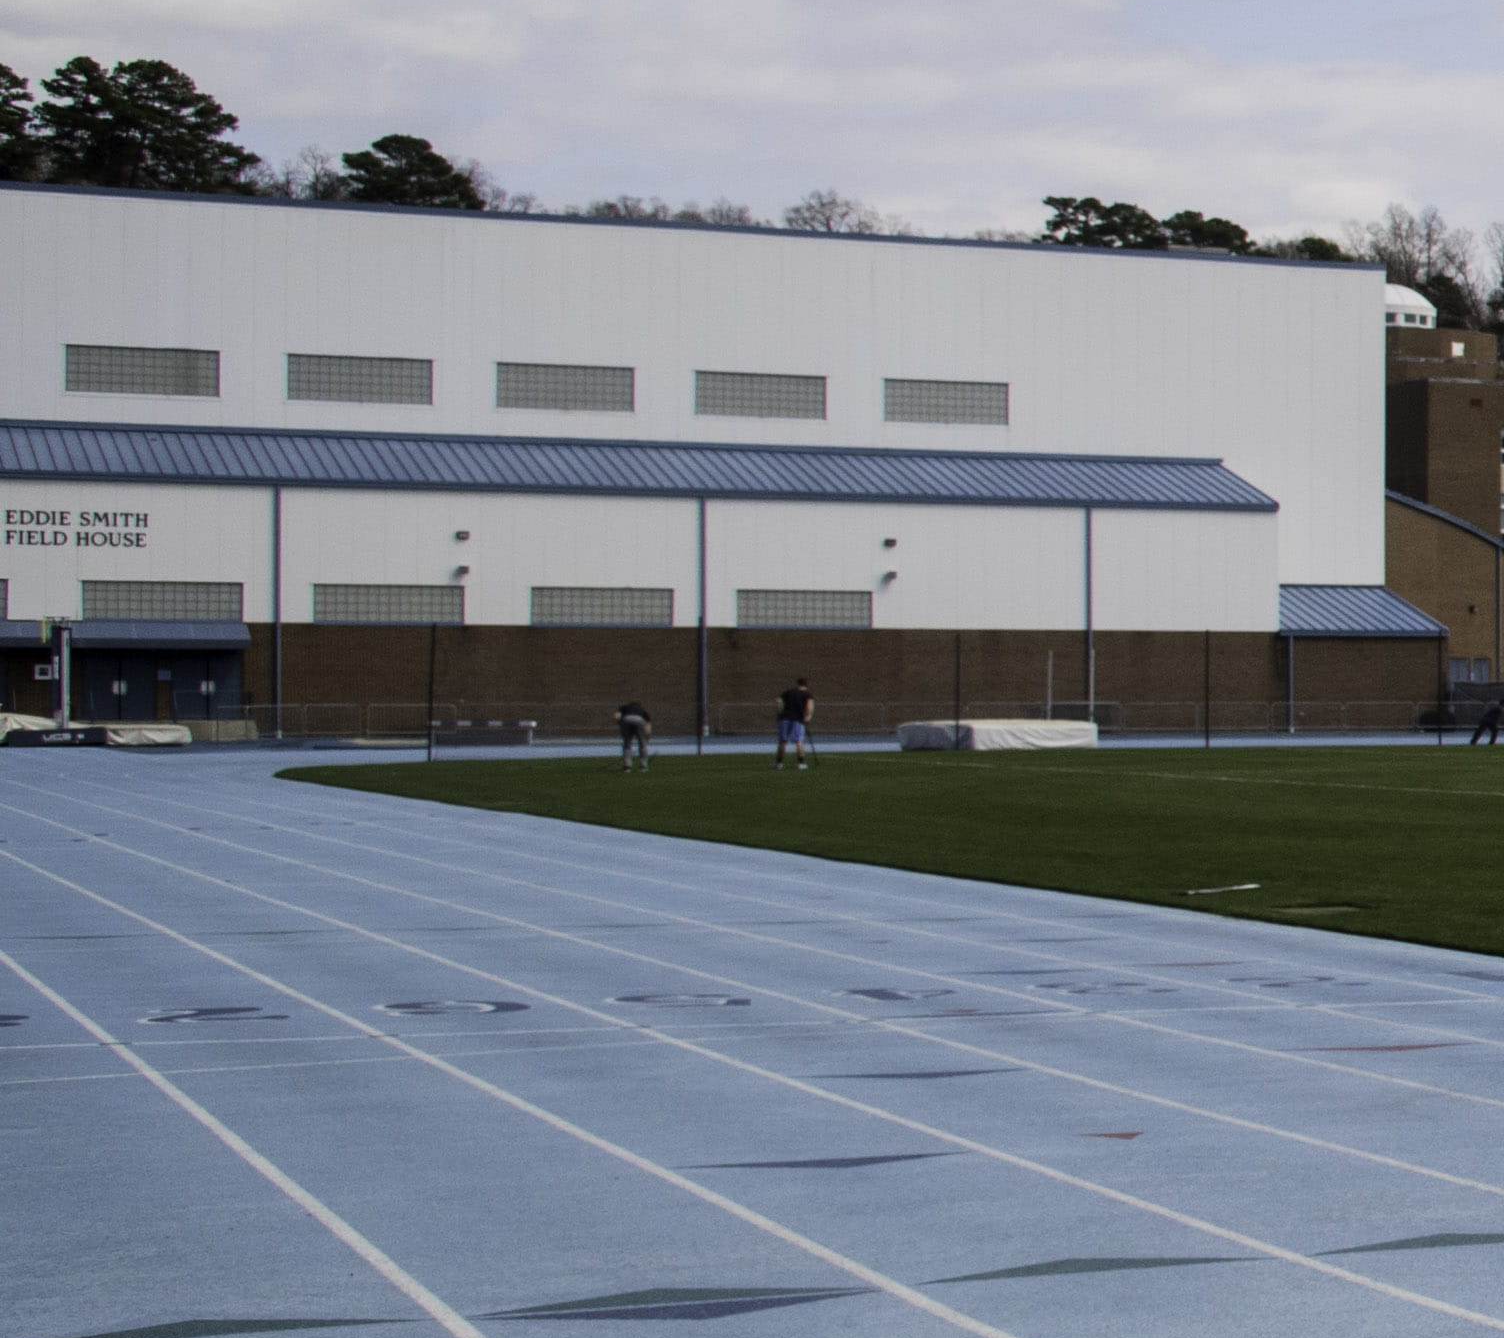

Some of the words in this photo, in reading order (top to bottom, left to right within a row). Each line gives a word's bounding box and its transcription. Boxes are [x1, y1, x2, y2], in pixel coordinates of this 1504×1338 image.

[5, 509, 71, 526] EDDIE
[79, 511, 149, 528] SMITH
[5, 529, 68, 546] FIELD
[76, 531, 148, 548] HOUSE
